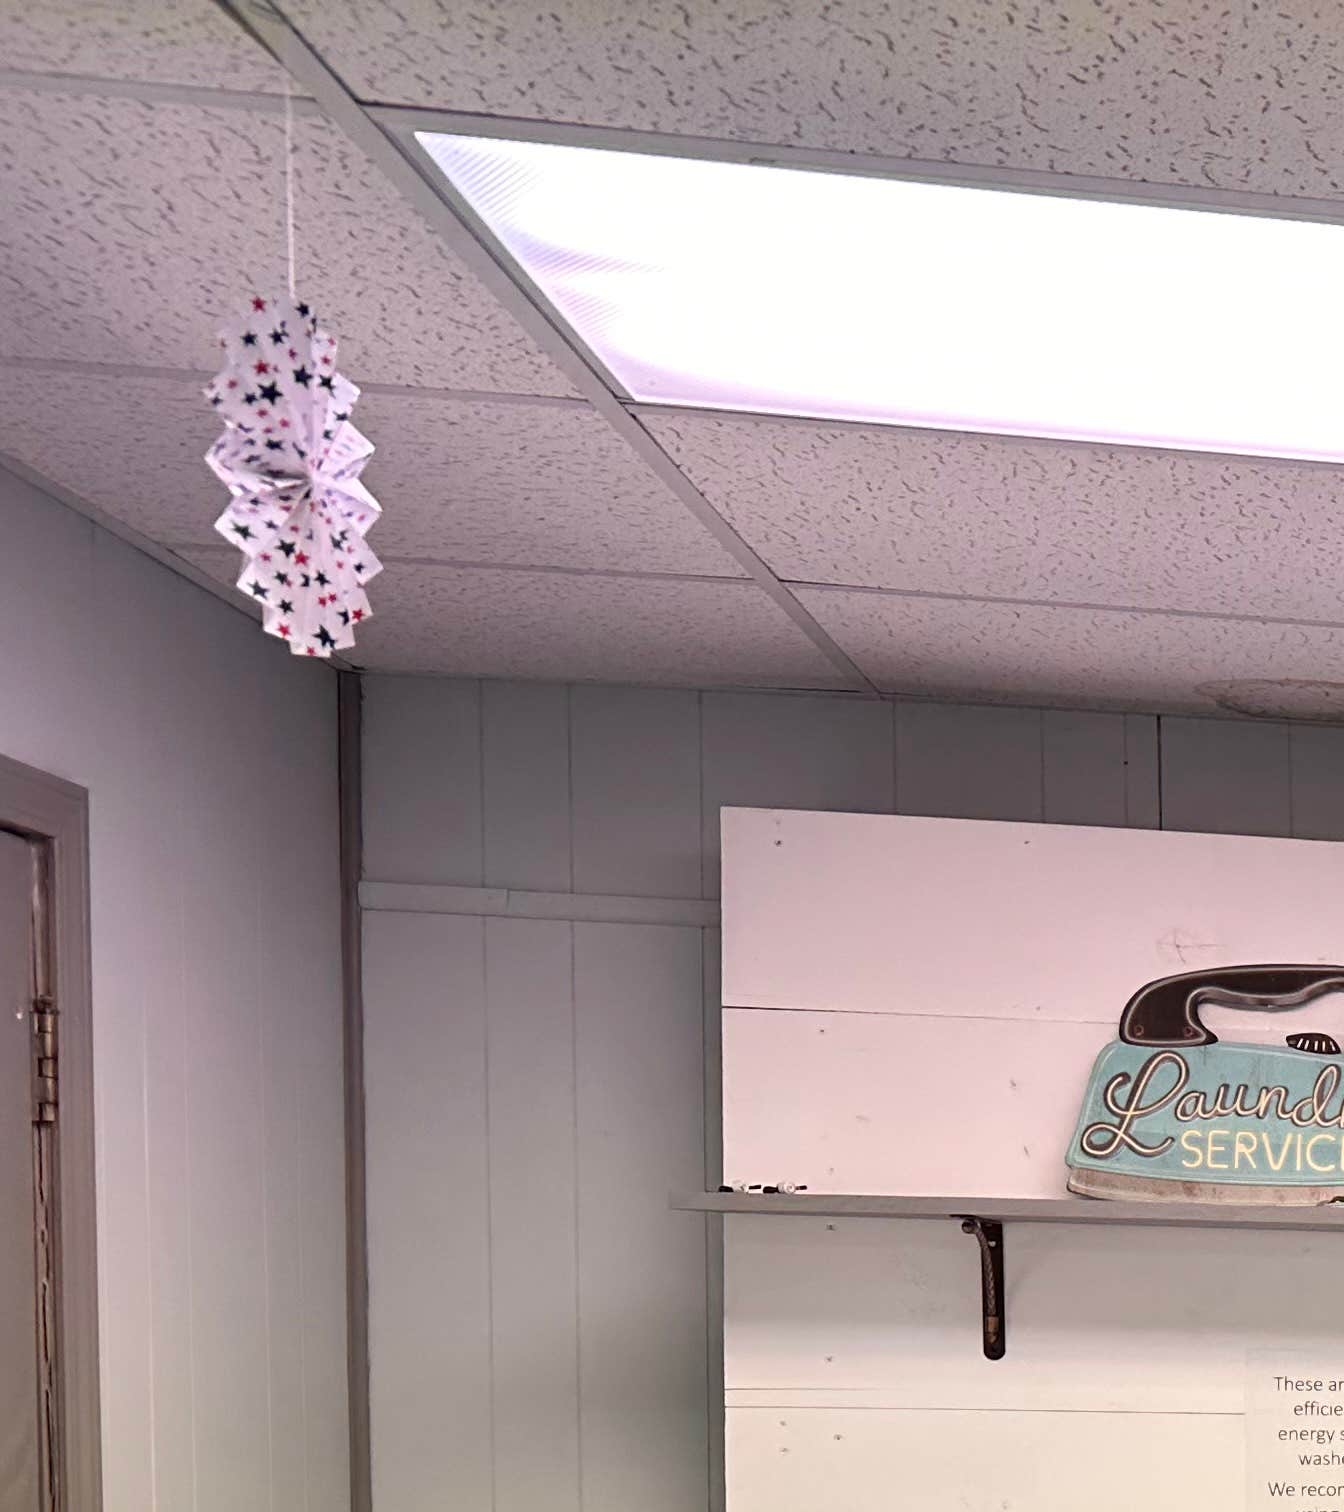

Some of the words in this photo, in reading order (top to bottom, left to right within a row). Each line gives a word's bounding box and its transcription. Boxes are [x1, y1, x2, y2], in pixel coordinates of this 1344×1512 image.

[1273, 1376, 1323, 1392] These
[1278, 1428, 1335, 1444] energy
[1268, 1482, 1296, 1497] We
